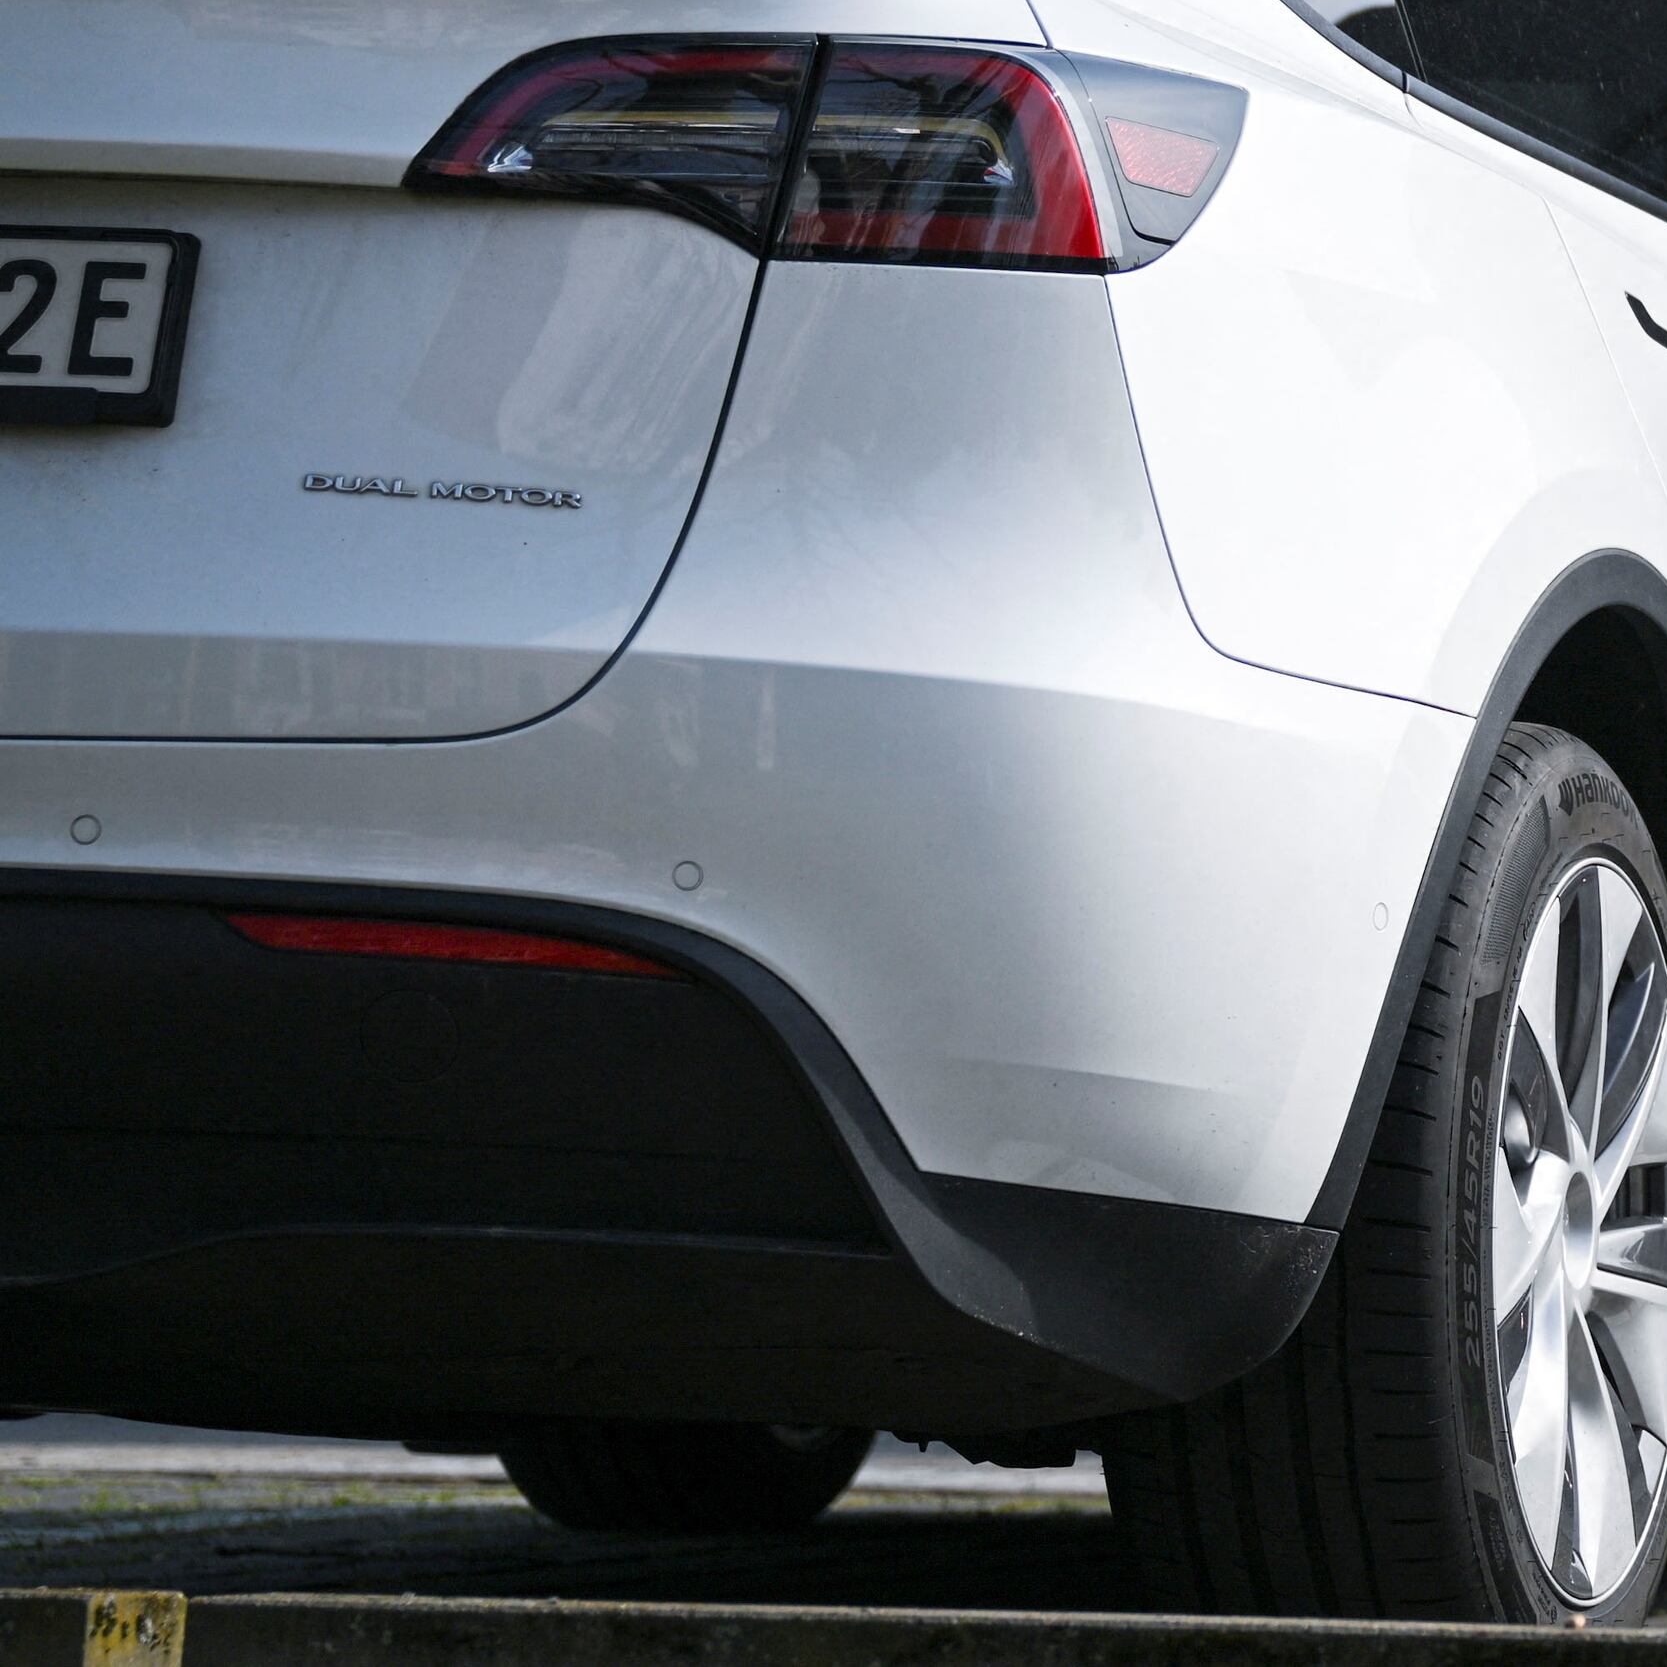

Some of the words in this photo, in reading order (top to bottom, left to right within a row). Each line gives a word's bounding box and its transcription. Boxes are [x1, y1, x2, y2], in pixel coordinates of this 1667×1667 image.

[0, 258, 147, 377] 2E
[303, 473, 418, 497] DUAL
[430, 480, 582, 509] MOTOR
[1461, 1075, 1486, 1368] 255/45R19
